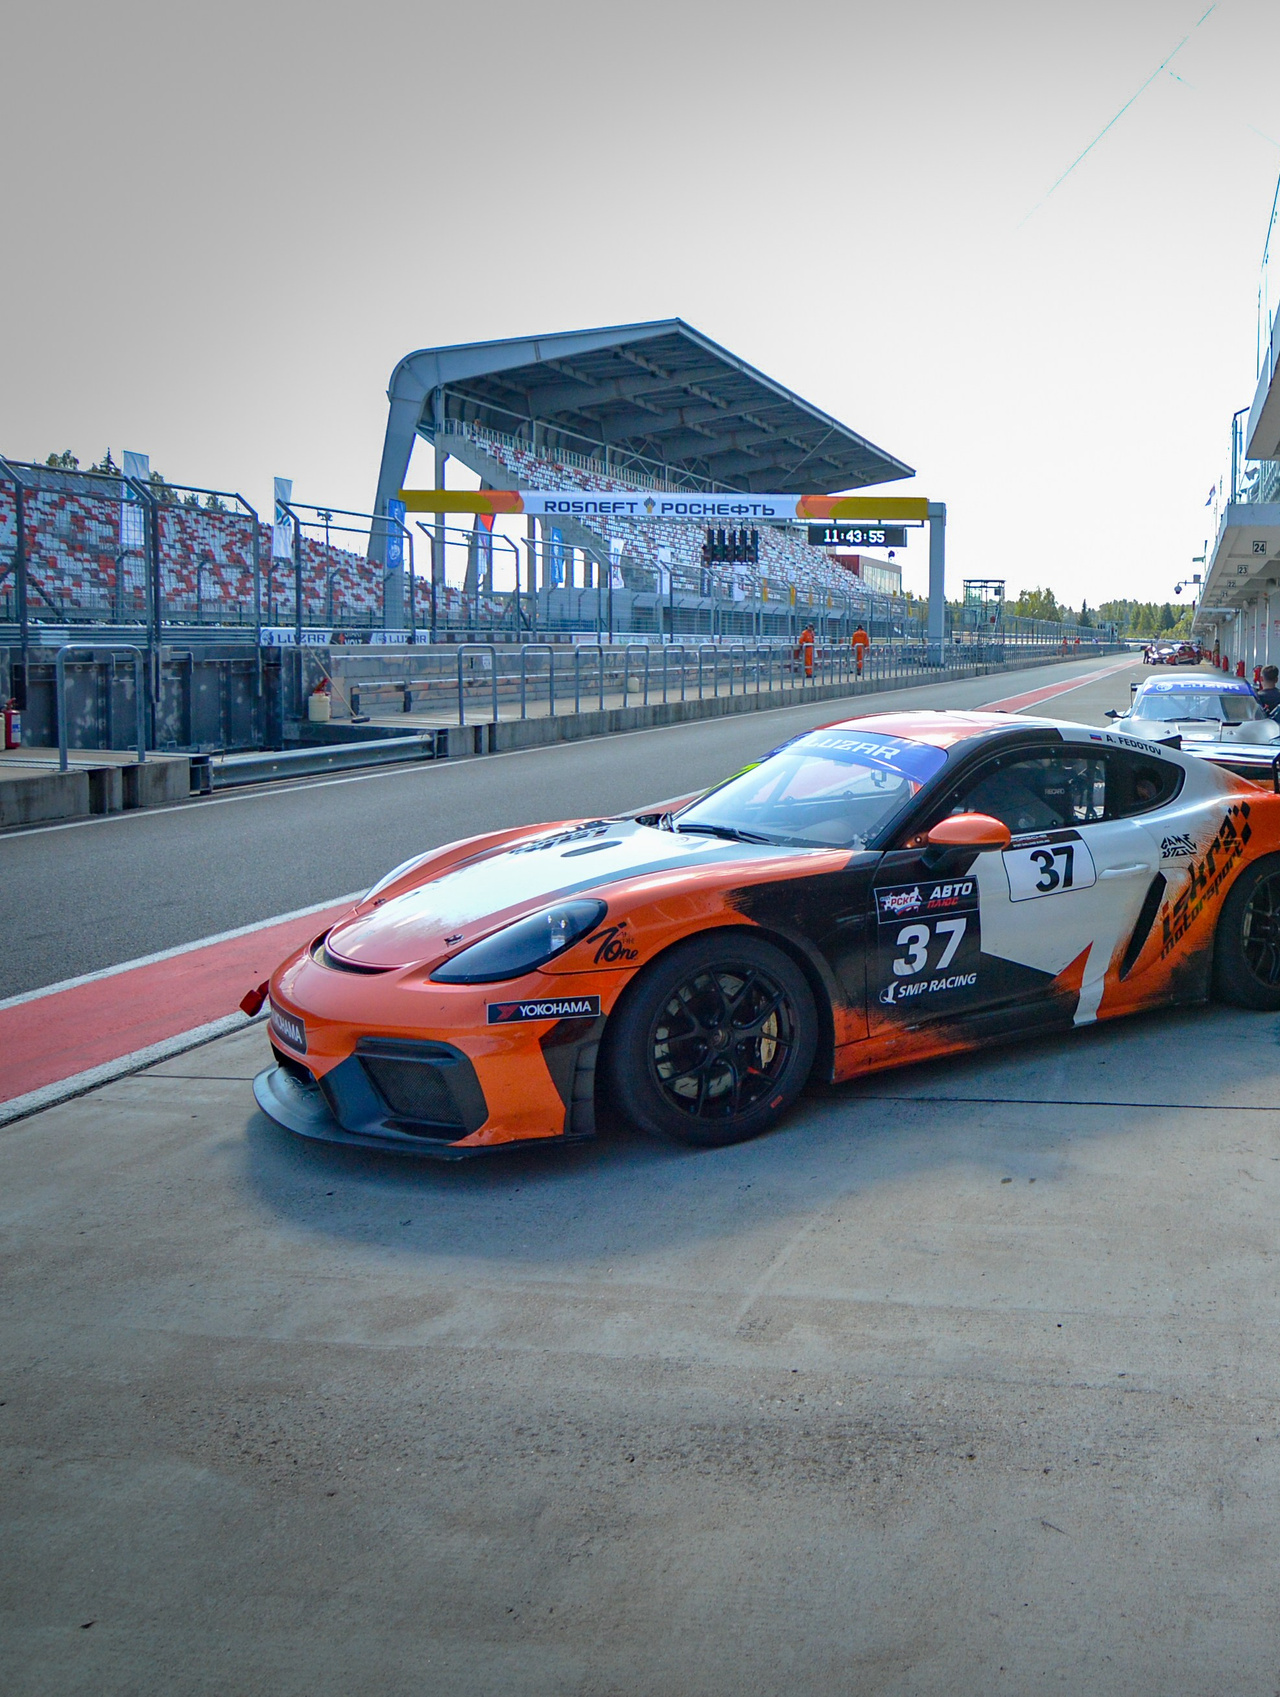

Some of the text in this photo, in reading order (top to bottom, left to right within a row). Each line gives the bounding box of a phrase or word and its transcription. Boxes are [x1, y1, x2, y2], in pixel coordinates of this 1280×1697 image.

[544, 500, 638, 515] ROSNEFT
[661, 502, 775, 517] РОСНЕФТЬ
[823, 528, 886, 543] 11:43:55
[1254, 543, 1265, 552] 24
[806, 737, 901, 760] LUZAR
[1106, 734, 1162, 756] A. FEDOTOV
[1029, 845, 1075, 892] 37
[929, 882, 973, 900] АВТО
[892, 917, 967, 976] 37
[897, 973, 977, 998] SMP RACING
[519, 1001, 592, 1017] YOKOHAMA
